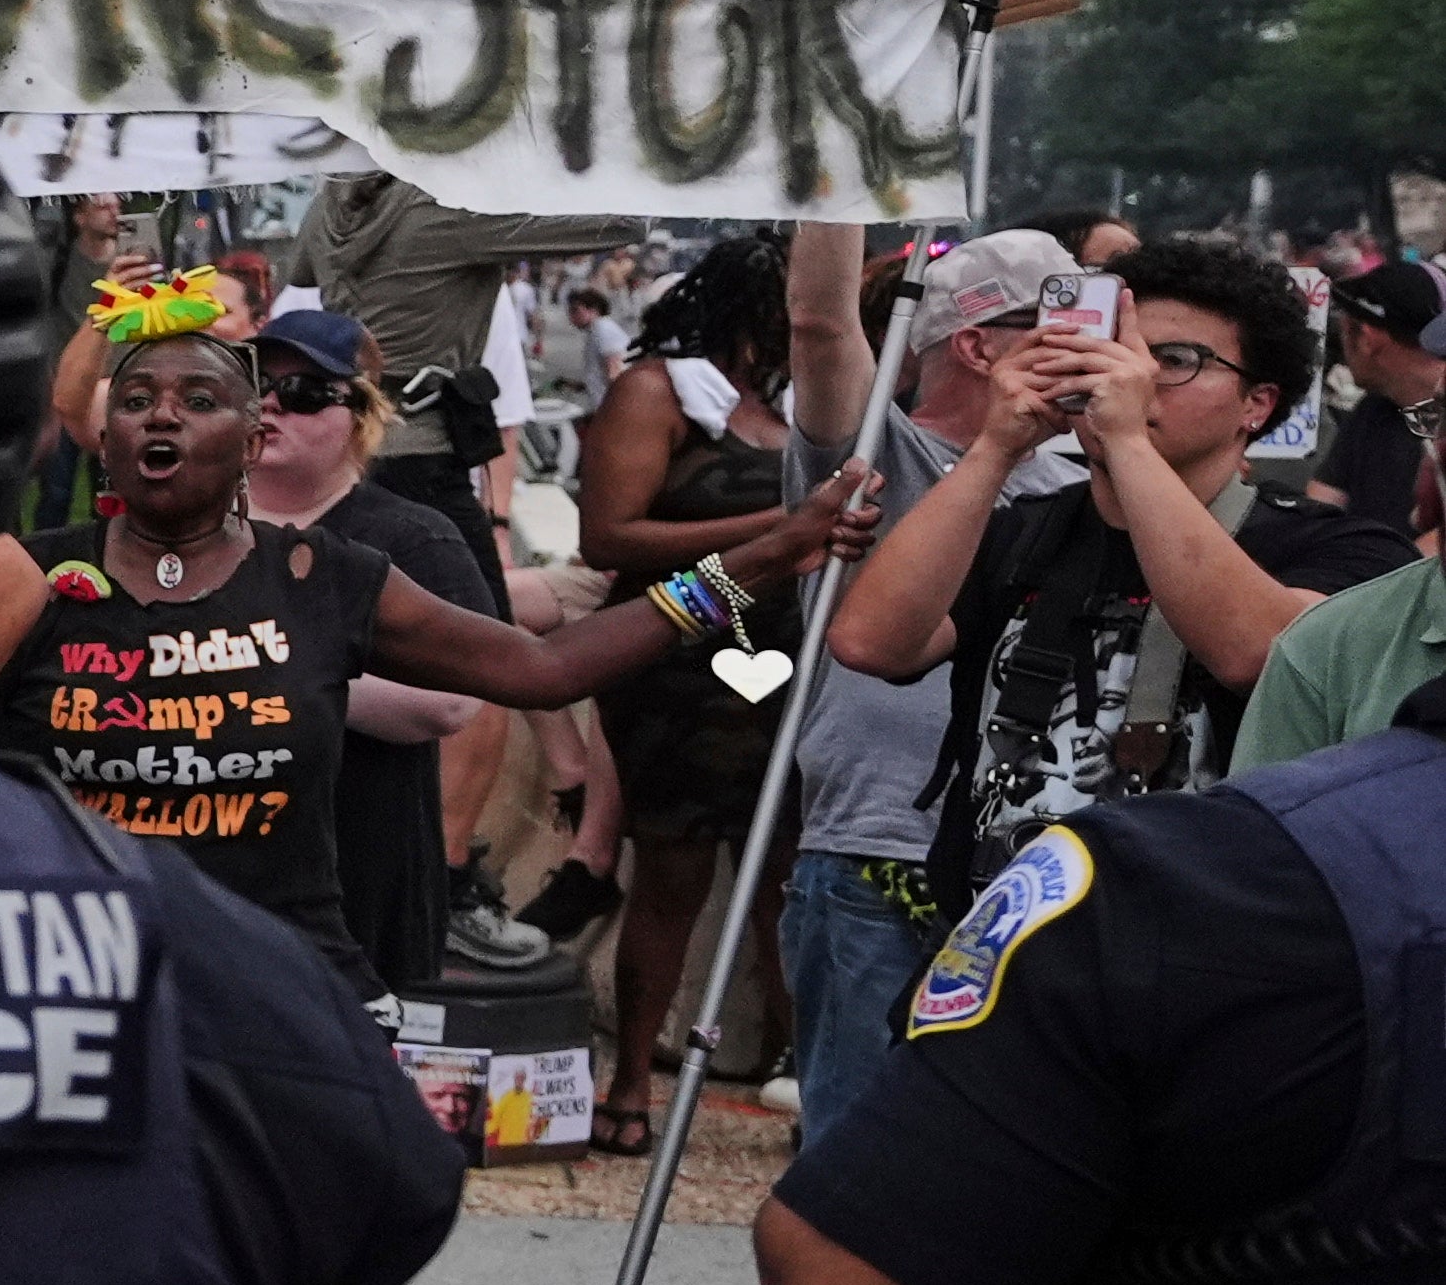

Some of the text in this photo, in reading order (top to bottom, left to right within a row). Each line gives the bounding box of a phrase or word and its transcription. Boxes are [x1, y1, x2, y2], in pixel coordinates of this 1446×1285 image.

[61, 619, 290, 682] Why Didn't
[53, 746, 293, 787] Mother
